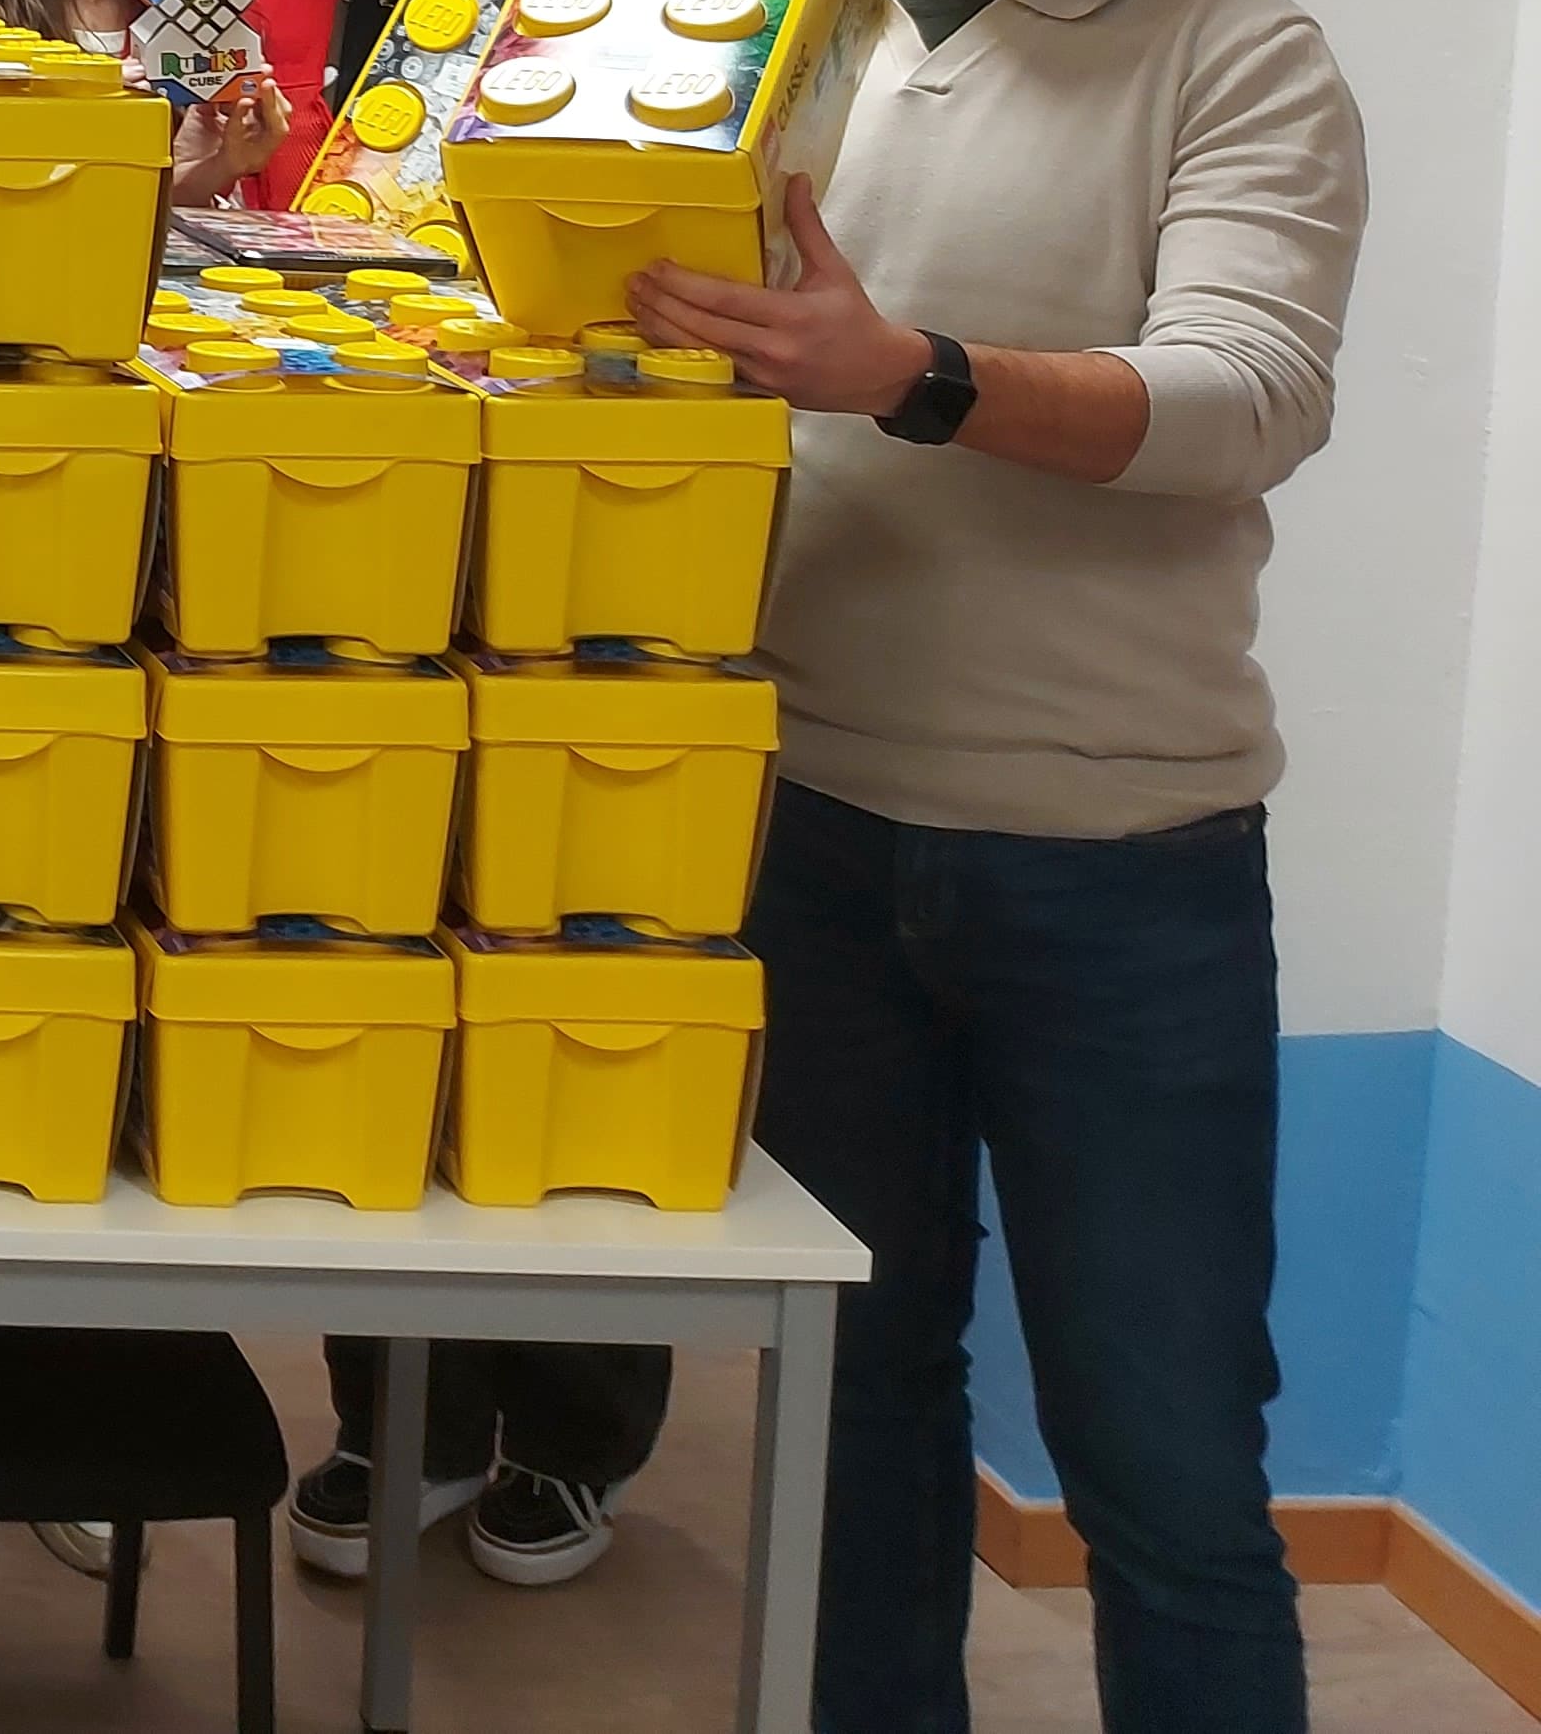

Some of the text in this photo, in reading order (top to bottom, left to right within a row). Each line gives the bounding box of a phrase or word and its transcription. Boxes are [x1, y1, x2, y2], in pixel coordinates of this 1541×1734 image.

[188, 75, 224, 87] CUBE
[488, 69, 562, 91] LEGO
[639, 72, 716, 96] LEGO
